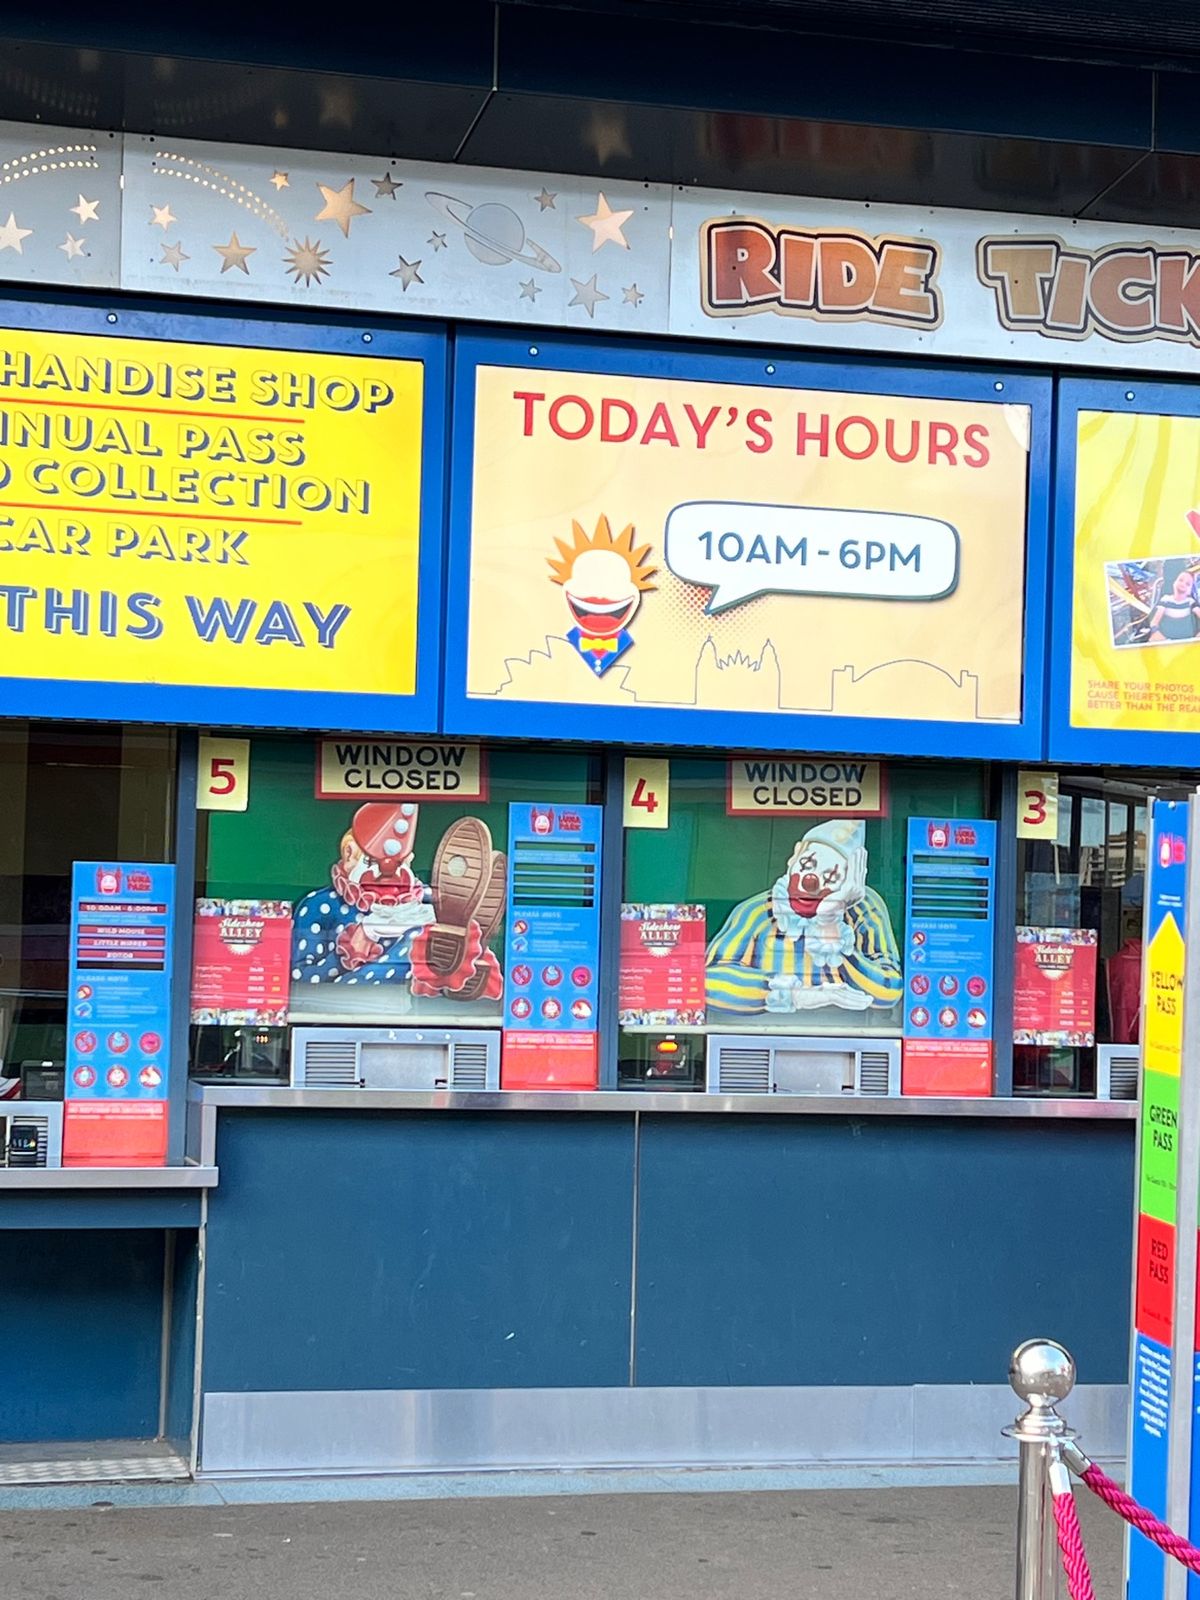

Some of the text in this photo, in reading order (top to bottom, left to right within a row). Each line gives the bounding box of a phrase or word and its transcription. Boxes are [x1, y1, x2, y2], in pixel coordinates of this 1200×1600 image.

[707, 219, 940, 322] RIDE
[0, 350, 393, 413] HANDISE SHOP
[513, 391, 991, 468] TODAY'S HOURS
[178, 423, 305, 465] PASS
[25, 458, 370, 514] COLLECTION
[106, 522, 249, 565] PARK
[698, 531, 807, 566] 10AM
[839, 539, 921, 572] 6PM
[0, 585, 351, 648] THIS WAY
[1087, 680, 1194, 693] SHARE YOUR PHOTOS
[1087, 690, 1119, 699] CAUSE
[1087, 700, 1121, 709] BETTER
[1126, 702, 1153, 711] THAN
[1157, 703, 1175, 712] THE
[336, 744, 466, 767] WINDOW
[209, 758, 236, 795] 5
[344, 769, 460, 790] CLOSED
[744, 763, 868, 784] WINDOW
[631, 778, 658, 813] 4
[753, 786, 862, 807] CLOSED
[1023, 790, 1047, 825] 3
[219, 928, 262, 938] ALLEY
[640, 931, 679, 940] ALLEY
[1035, 954, 1072, 964] ALLEY
[1151, 971, 1184, 992] YELLOW
[1156, 997, 1177, 1016] PASS
[1149, 1104, 1178, 1130] GREEN
[1152, 1130, 1173, 1152] PASS
[1150, 1238, 1169, 1262] RED
[1149, 1261, 1169, 1285] PASS
